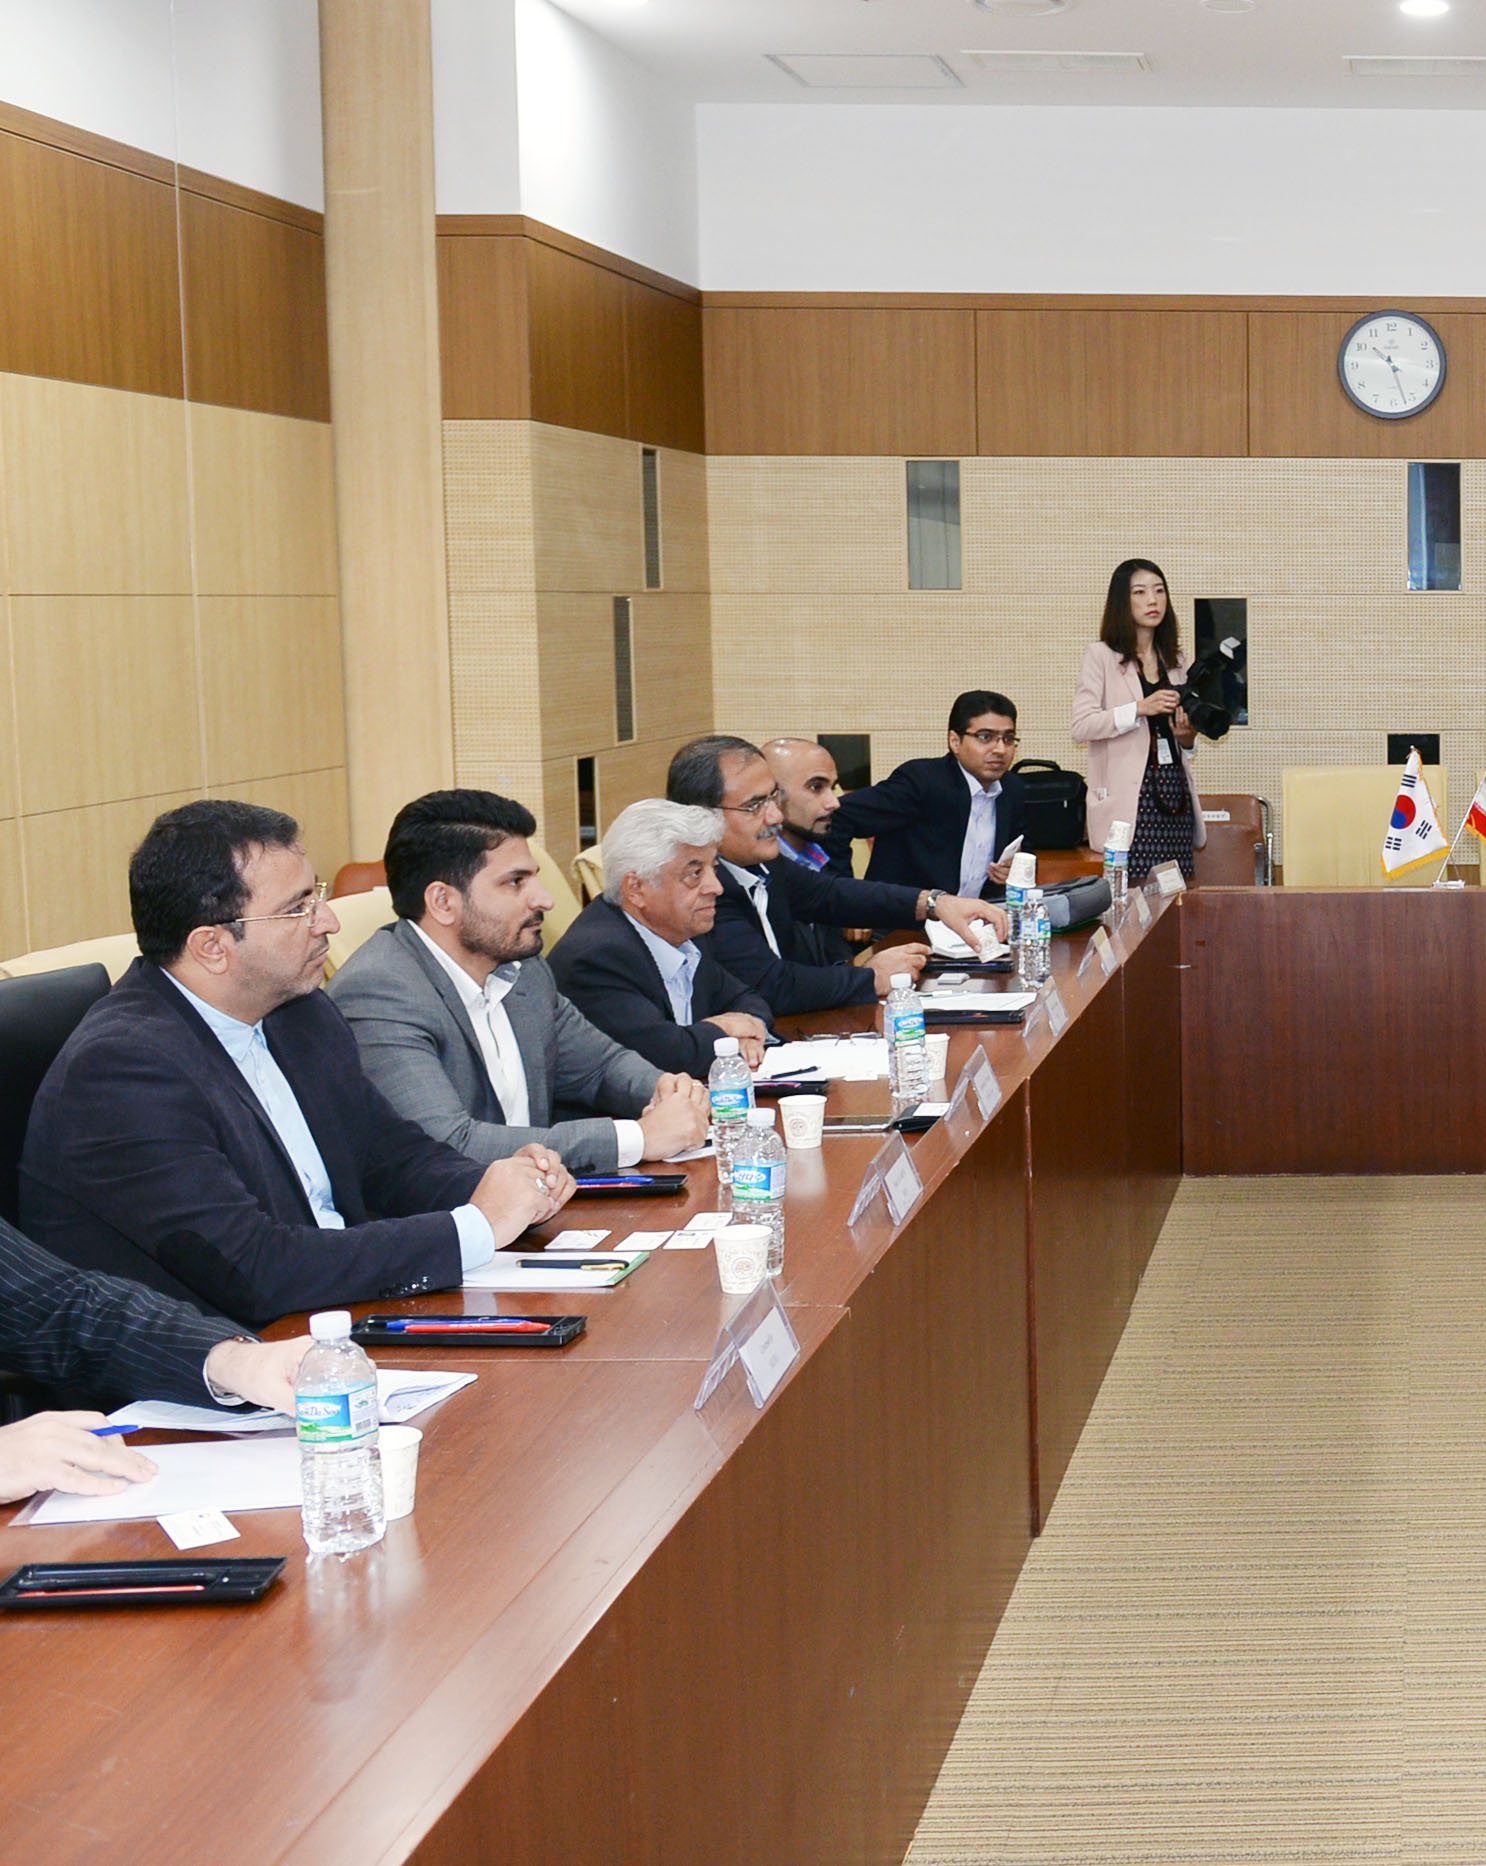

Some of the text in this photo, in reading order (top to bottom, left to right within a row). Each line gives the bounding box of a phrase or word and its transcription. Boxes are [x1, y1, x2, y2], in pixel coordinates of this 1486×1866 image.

[1386, 322, 1398, 332] 12
[1407, 327, 1412, 337] 1
[1369, 328, 1378, 337] 11
[1356, 342, 1367, 352] 10
[1420, 341, 1429, 351] 2
[1351, 361, 1359, 370] 9
[1426, 359, 1434, 369] 3
[1357, 380, 1366, 390] 8
[1422, 378, 1429, 388] 4
[1372, 393, 1380, 403] 7
[1408, 392, 1416, 402] 5
